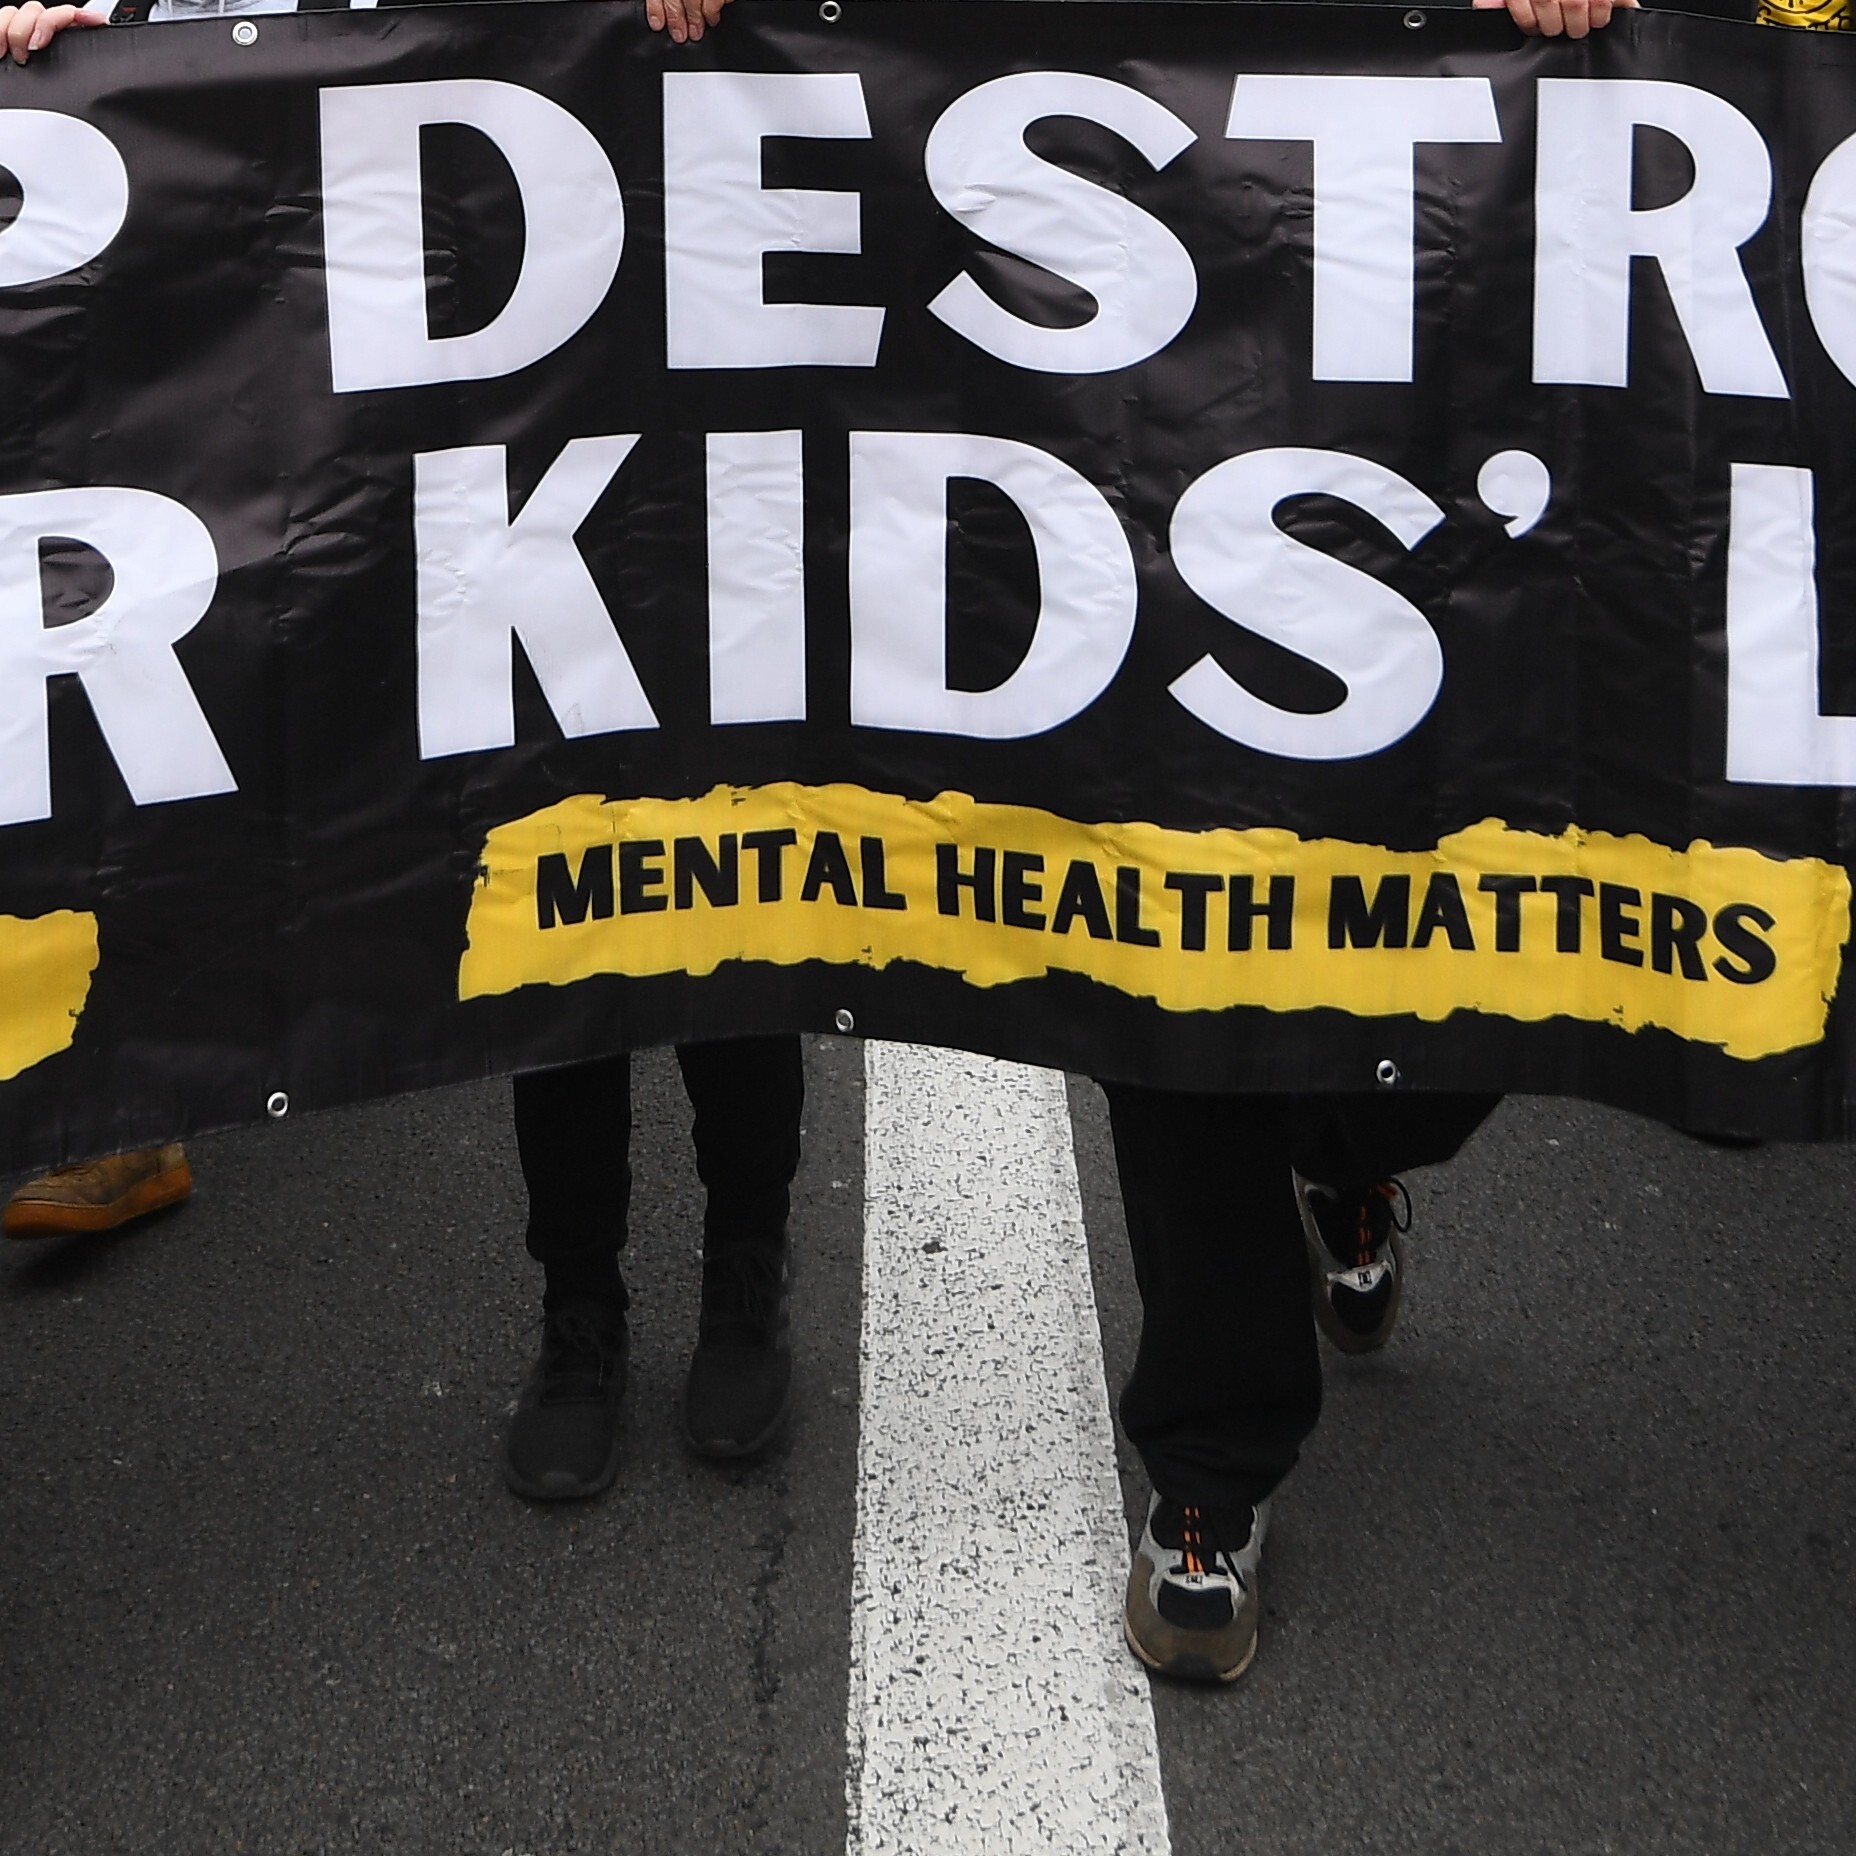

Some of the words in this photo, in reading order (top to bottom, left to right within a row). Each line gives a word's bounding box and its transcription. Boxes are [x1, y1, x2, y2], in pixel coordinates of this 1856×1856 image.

[537, 829, 907, 930] MENTAL
[935, 842, 1296, 952] HEALTH
[1327, 871, 1777, 985] MATTERS
